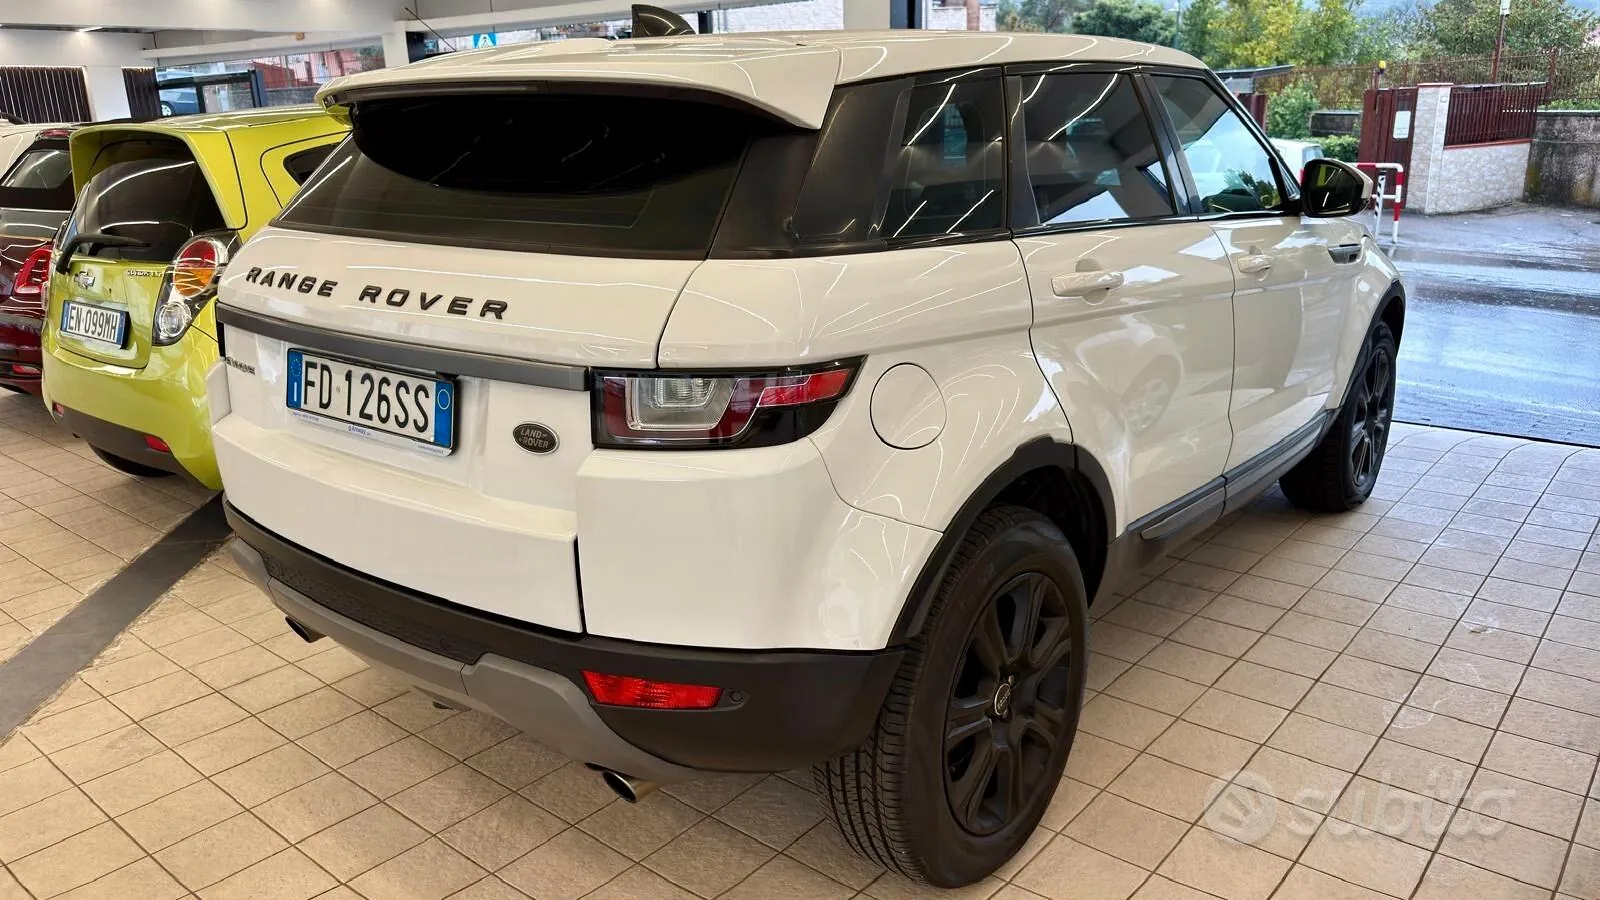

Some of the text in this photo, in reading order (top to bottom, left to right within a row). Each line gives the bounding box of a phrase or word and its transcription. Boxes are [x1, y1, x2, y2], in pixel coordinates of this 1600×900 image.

[245, 266, 509, 320] RANGE ROVER
[68, 305, 83, 332] EN
[84, 309, 118, 341] 099MH
[302, 360, 333, 411] FD
[344, 369, 430, 434] 126SS
